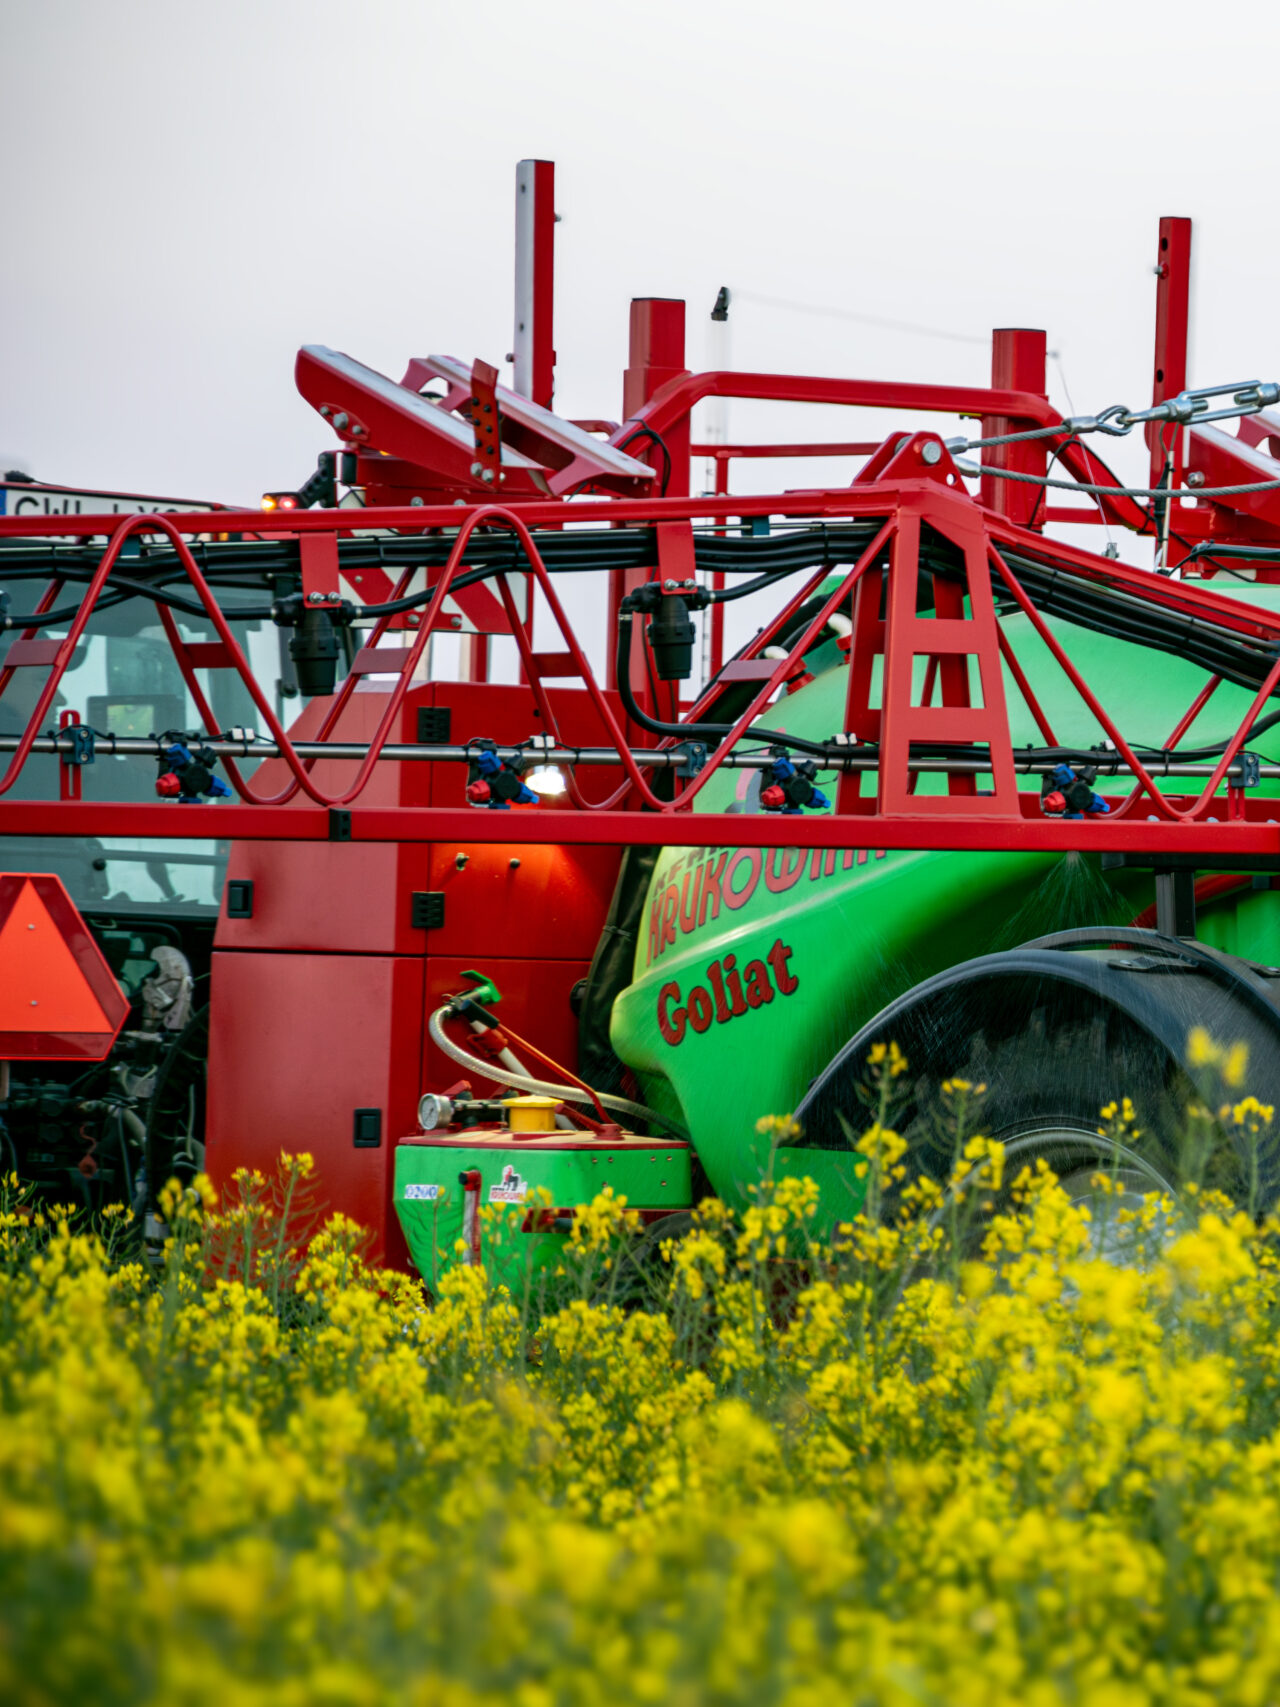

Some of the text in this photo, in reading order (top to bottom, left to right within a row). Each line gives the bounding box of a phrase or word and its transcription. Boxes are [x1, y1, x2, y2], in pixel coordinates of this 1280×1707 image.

[646, 847, 886, 968] KRUKOW
[654, 846, 724, 897] KFM
[656, 937, 800, 1046] Goliat
